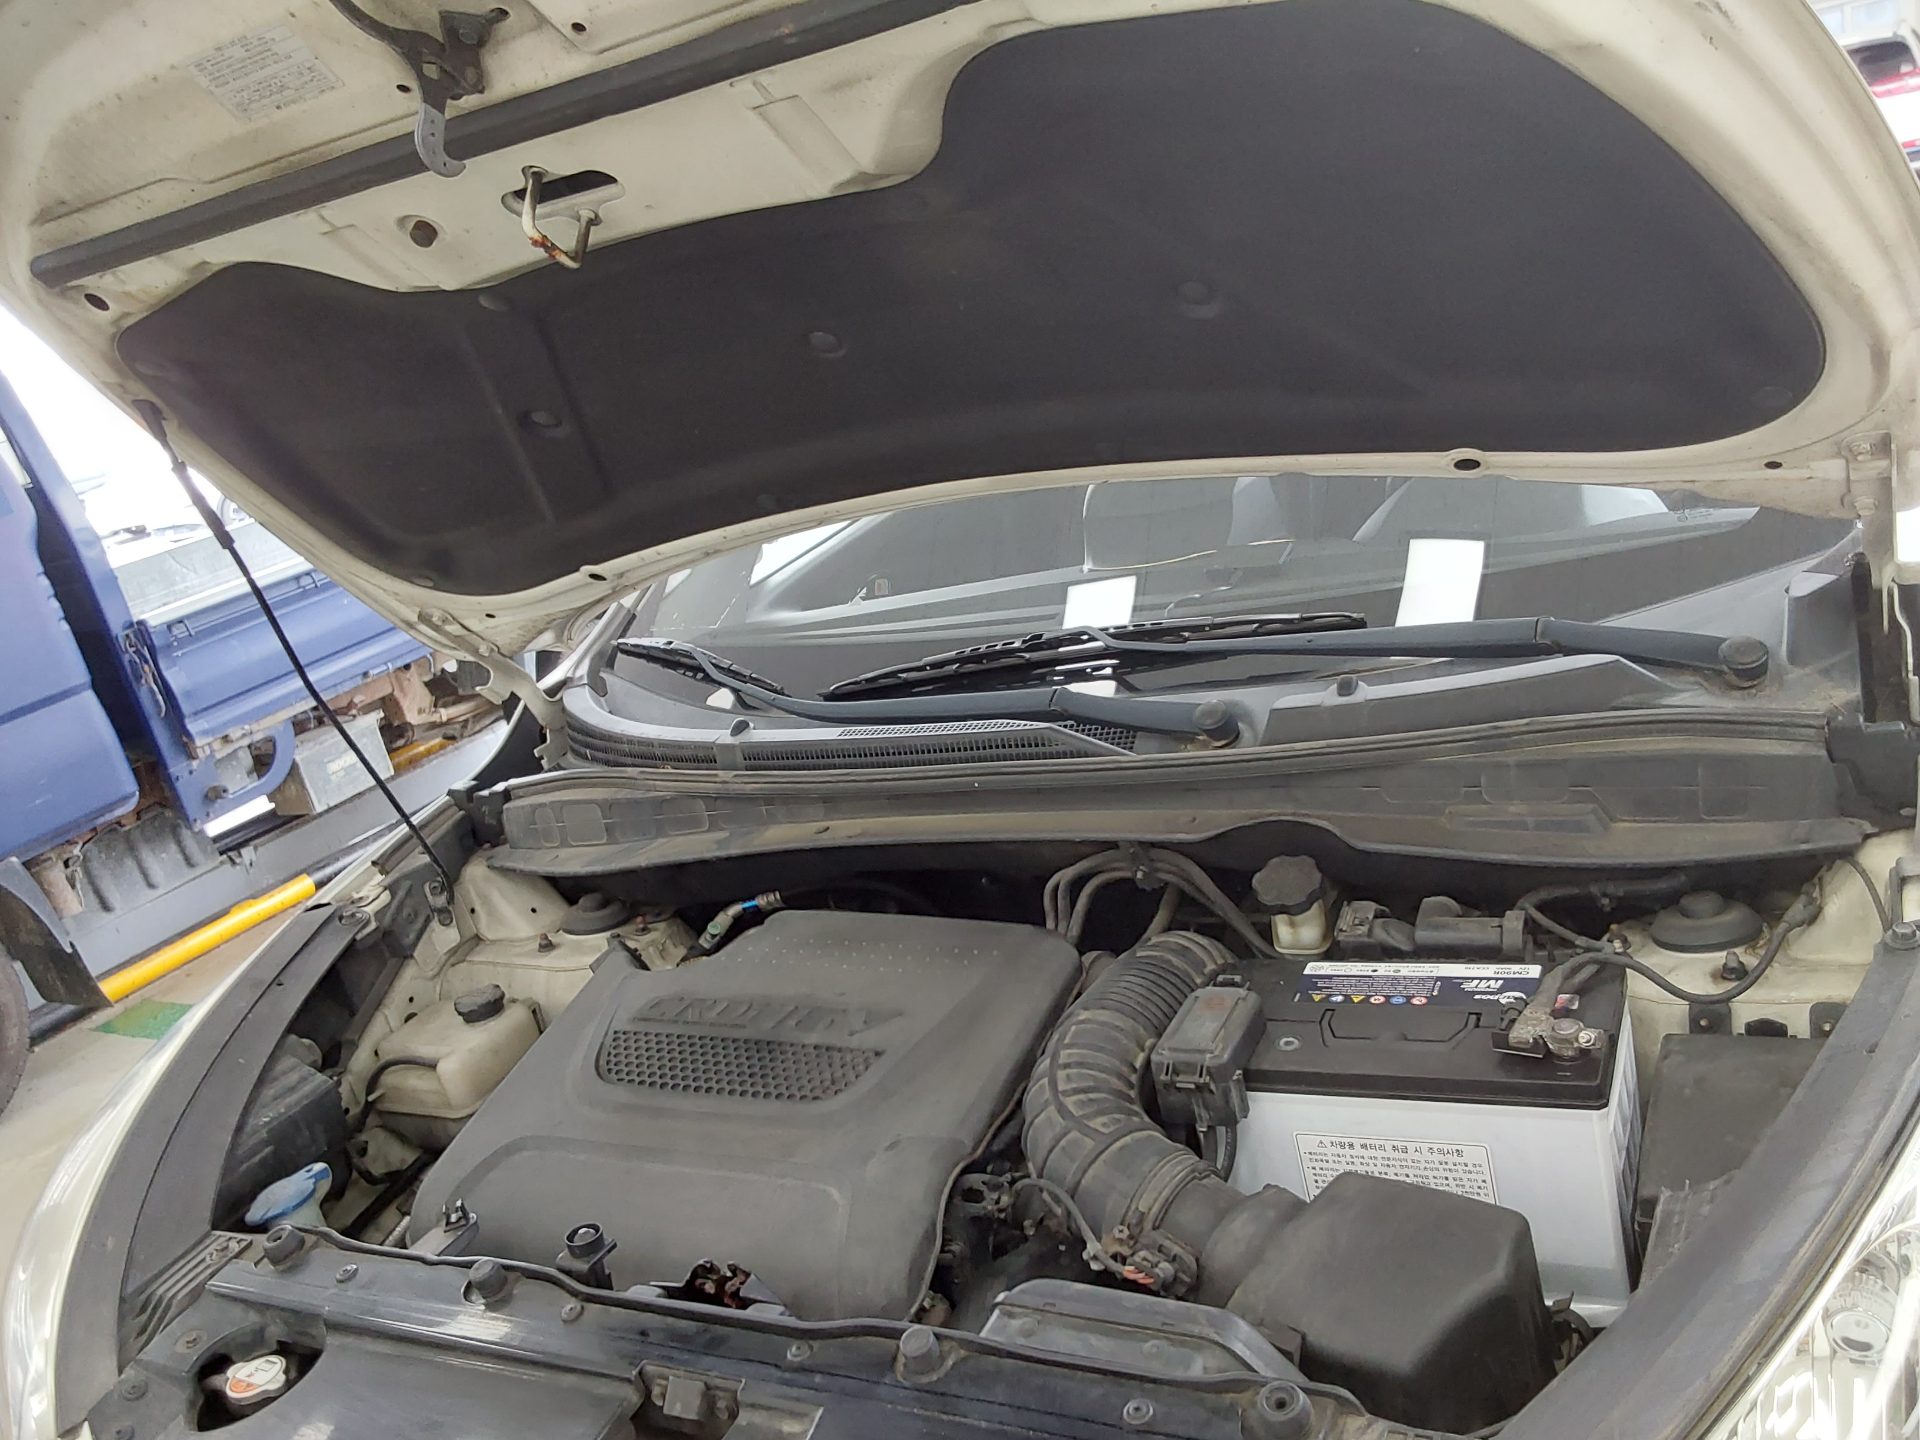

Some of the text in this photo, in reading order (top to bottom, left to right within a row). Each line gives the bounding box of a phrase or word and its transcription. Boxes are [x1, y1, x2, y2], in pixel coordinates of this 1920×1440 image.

[1459, 979, 1504, 989] MF
[1329, 1140, 1464, 1158] 차량용 배터리 취급 시 주의사항
